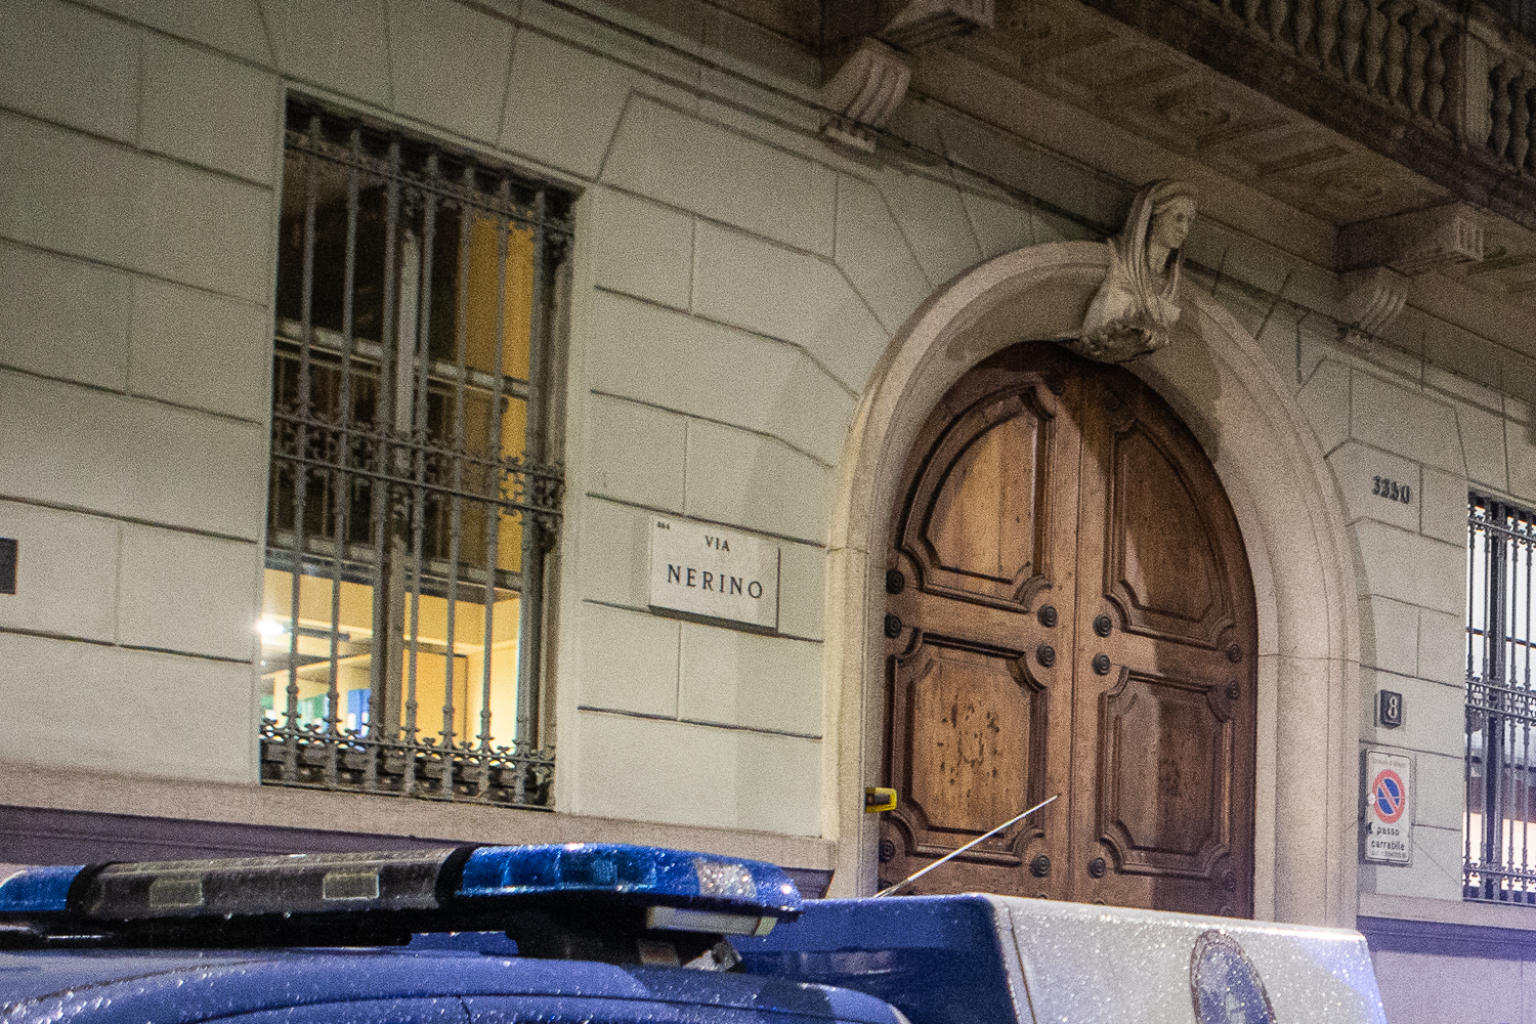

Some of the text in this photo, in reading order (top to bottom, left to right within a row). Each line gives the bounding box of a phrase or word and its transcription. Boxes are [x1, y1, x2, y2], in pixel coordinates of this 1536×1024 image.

[705, 535, 730, 551] VIA
[667, 563, 763, 599] NERINO
[1389, 696, 1398, 719] 8
[1376, 826, 1400, 837] passo
[1371, 840, 1405, 851] carrabile
